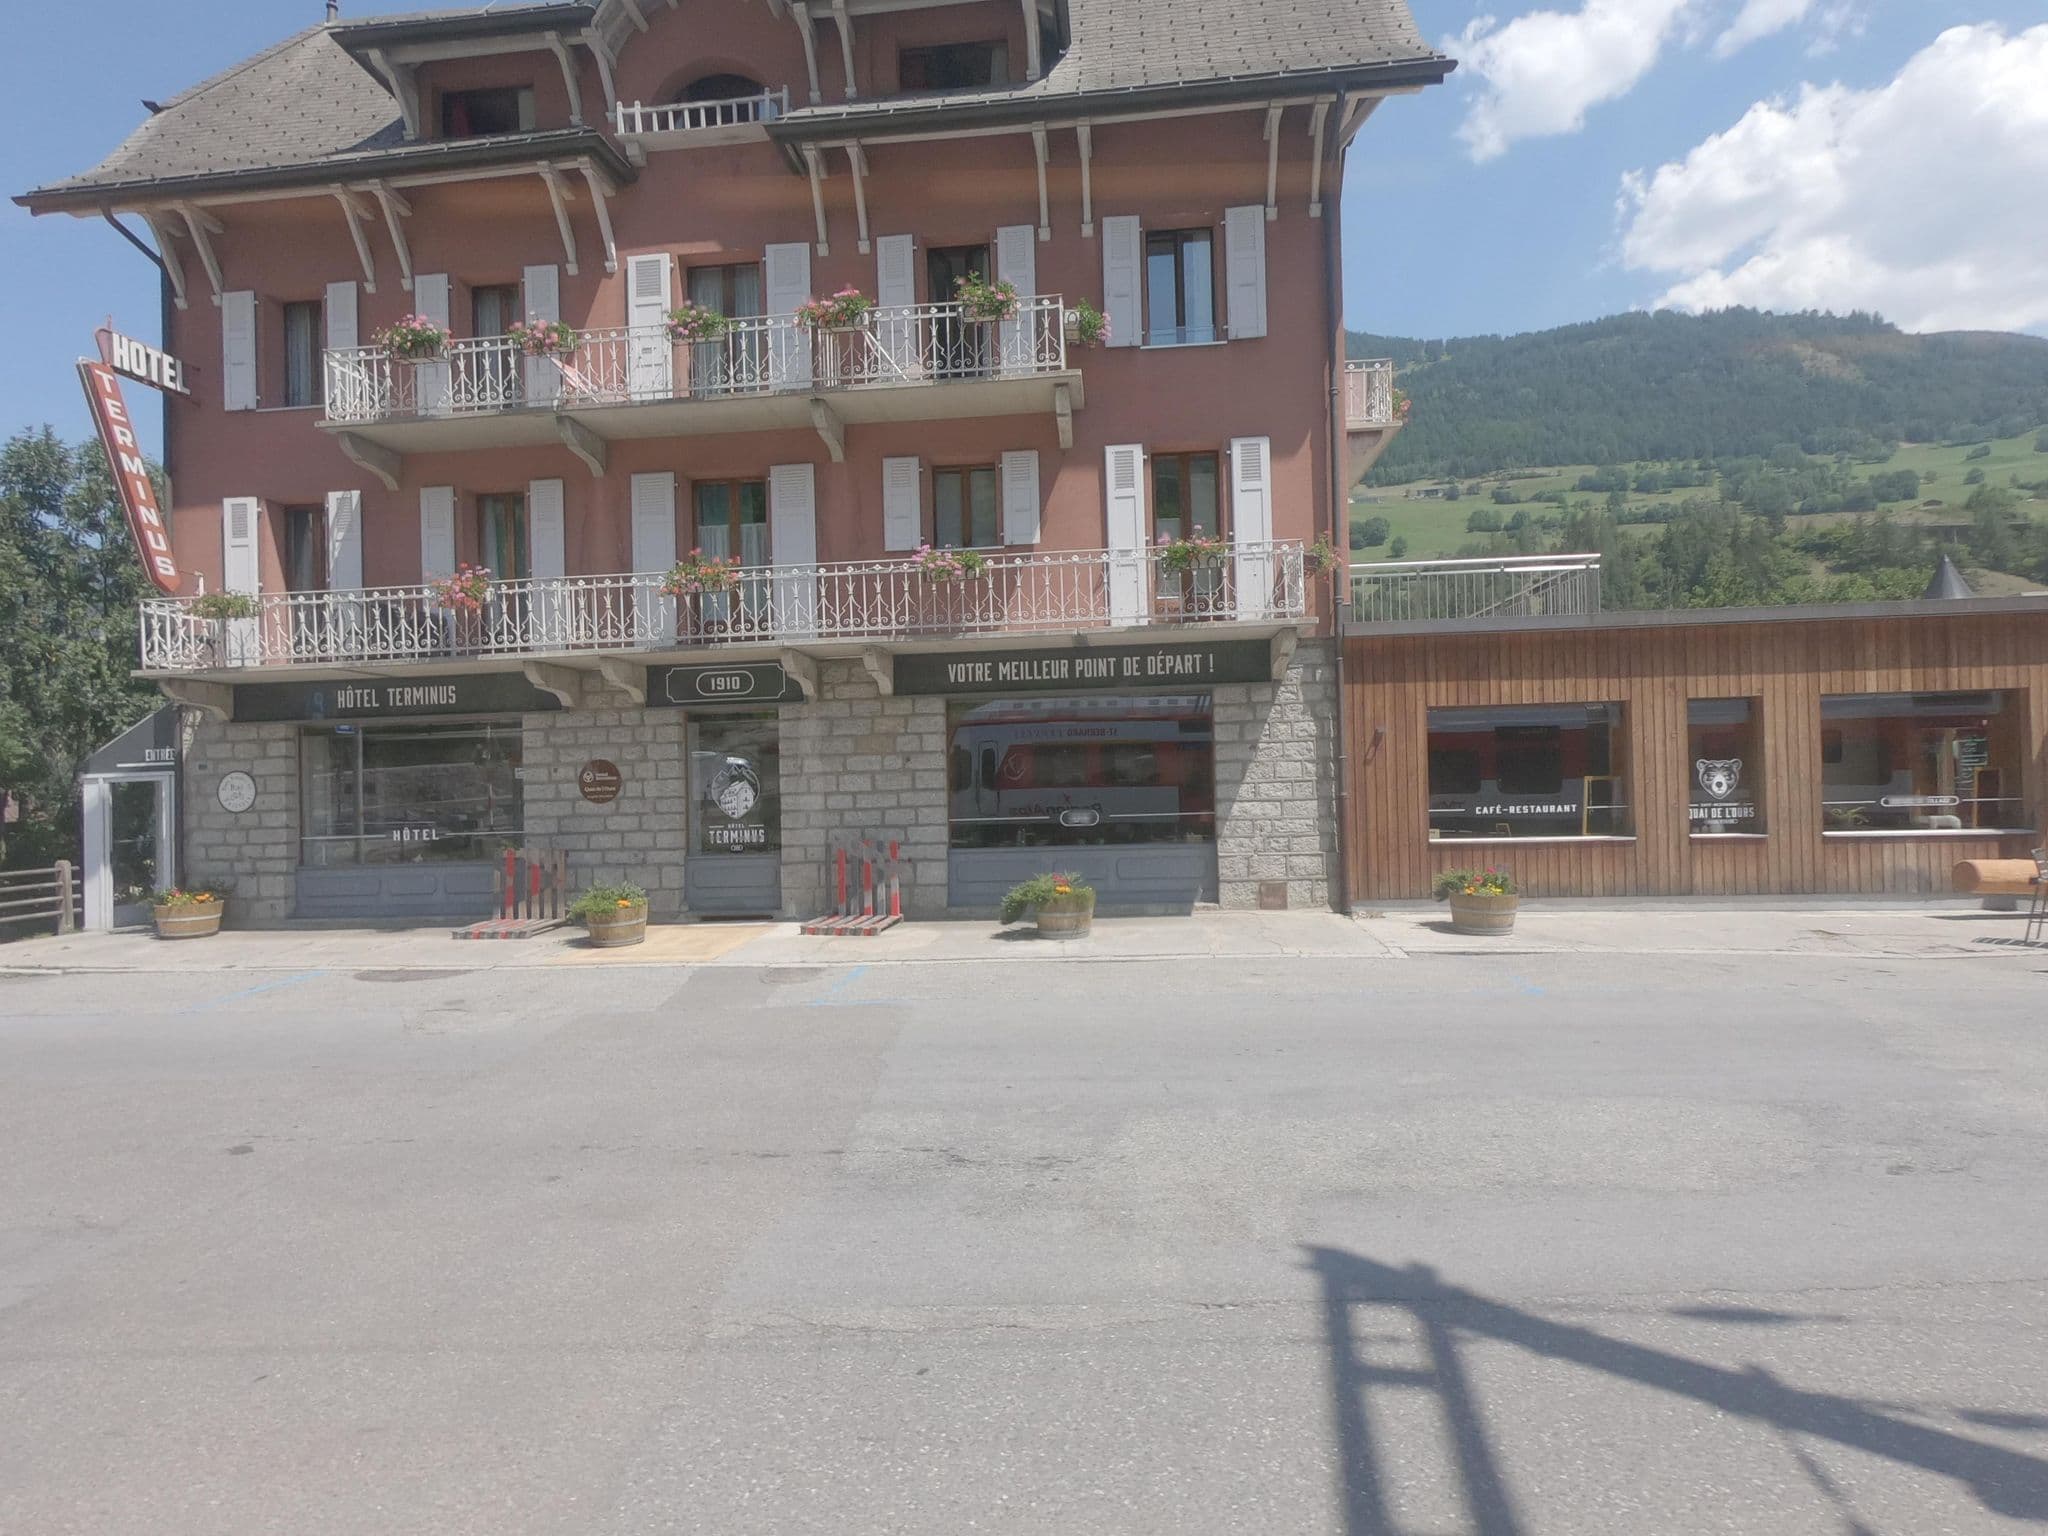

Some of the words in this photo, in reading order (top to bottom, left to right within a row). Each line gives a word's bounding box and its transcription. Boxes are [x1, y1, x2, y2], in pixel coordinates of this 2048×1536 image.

[112, 332, 191, 395] HOTEL
[94, 368, 176, 577] TERMINUS
[948, 662, 992, 682] VOTRE
[999, 659, 1069, 680] MEILLEUR
[1075, 657, 1116, 678] POINT
[1123, 656, 1141, 676] DE
[1147, 650, 1202, 675] DÉPART
[1209, 653, 1214, 672] !
[711, 676, 740, 690] 1910
[337, 684, 379, 708] HÔTEL
[387, 685, 457, 706] TERMINUS
[1475, 804, 1577, 815] CAFÉ-RESTAURANT
[1711, 808, 1723, 818] DE
[392, 827, 440, 841] HÔTEL
[709, 829, 765, 844] TERMINUS
